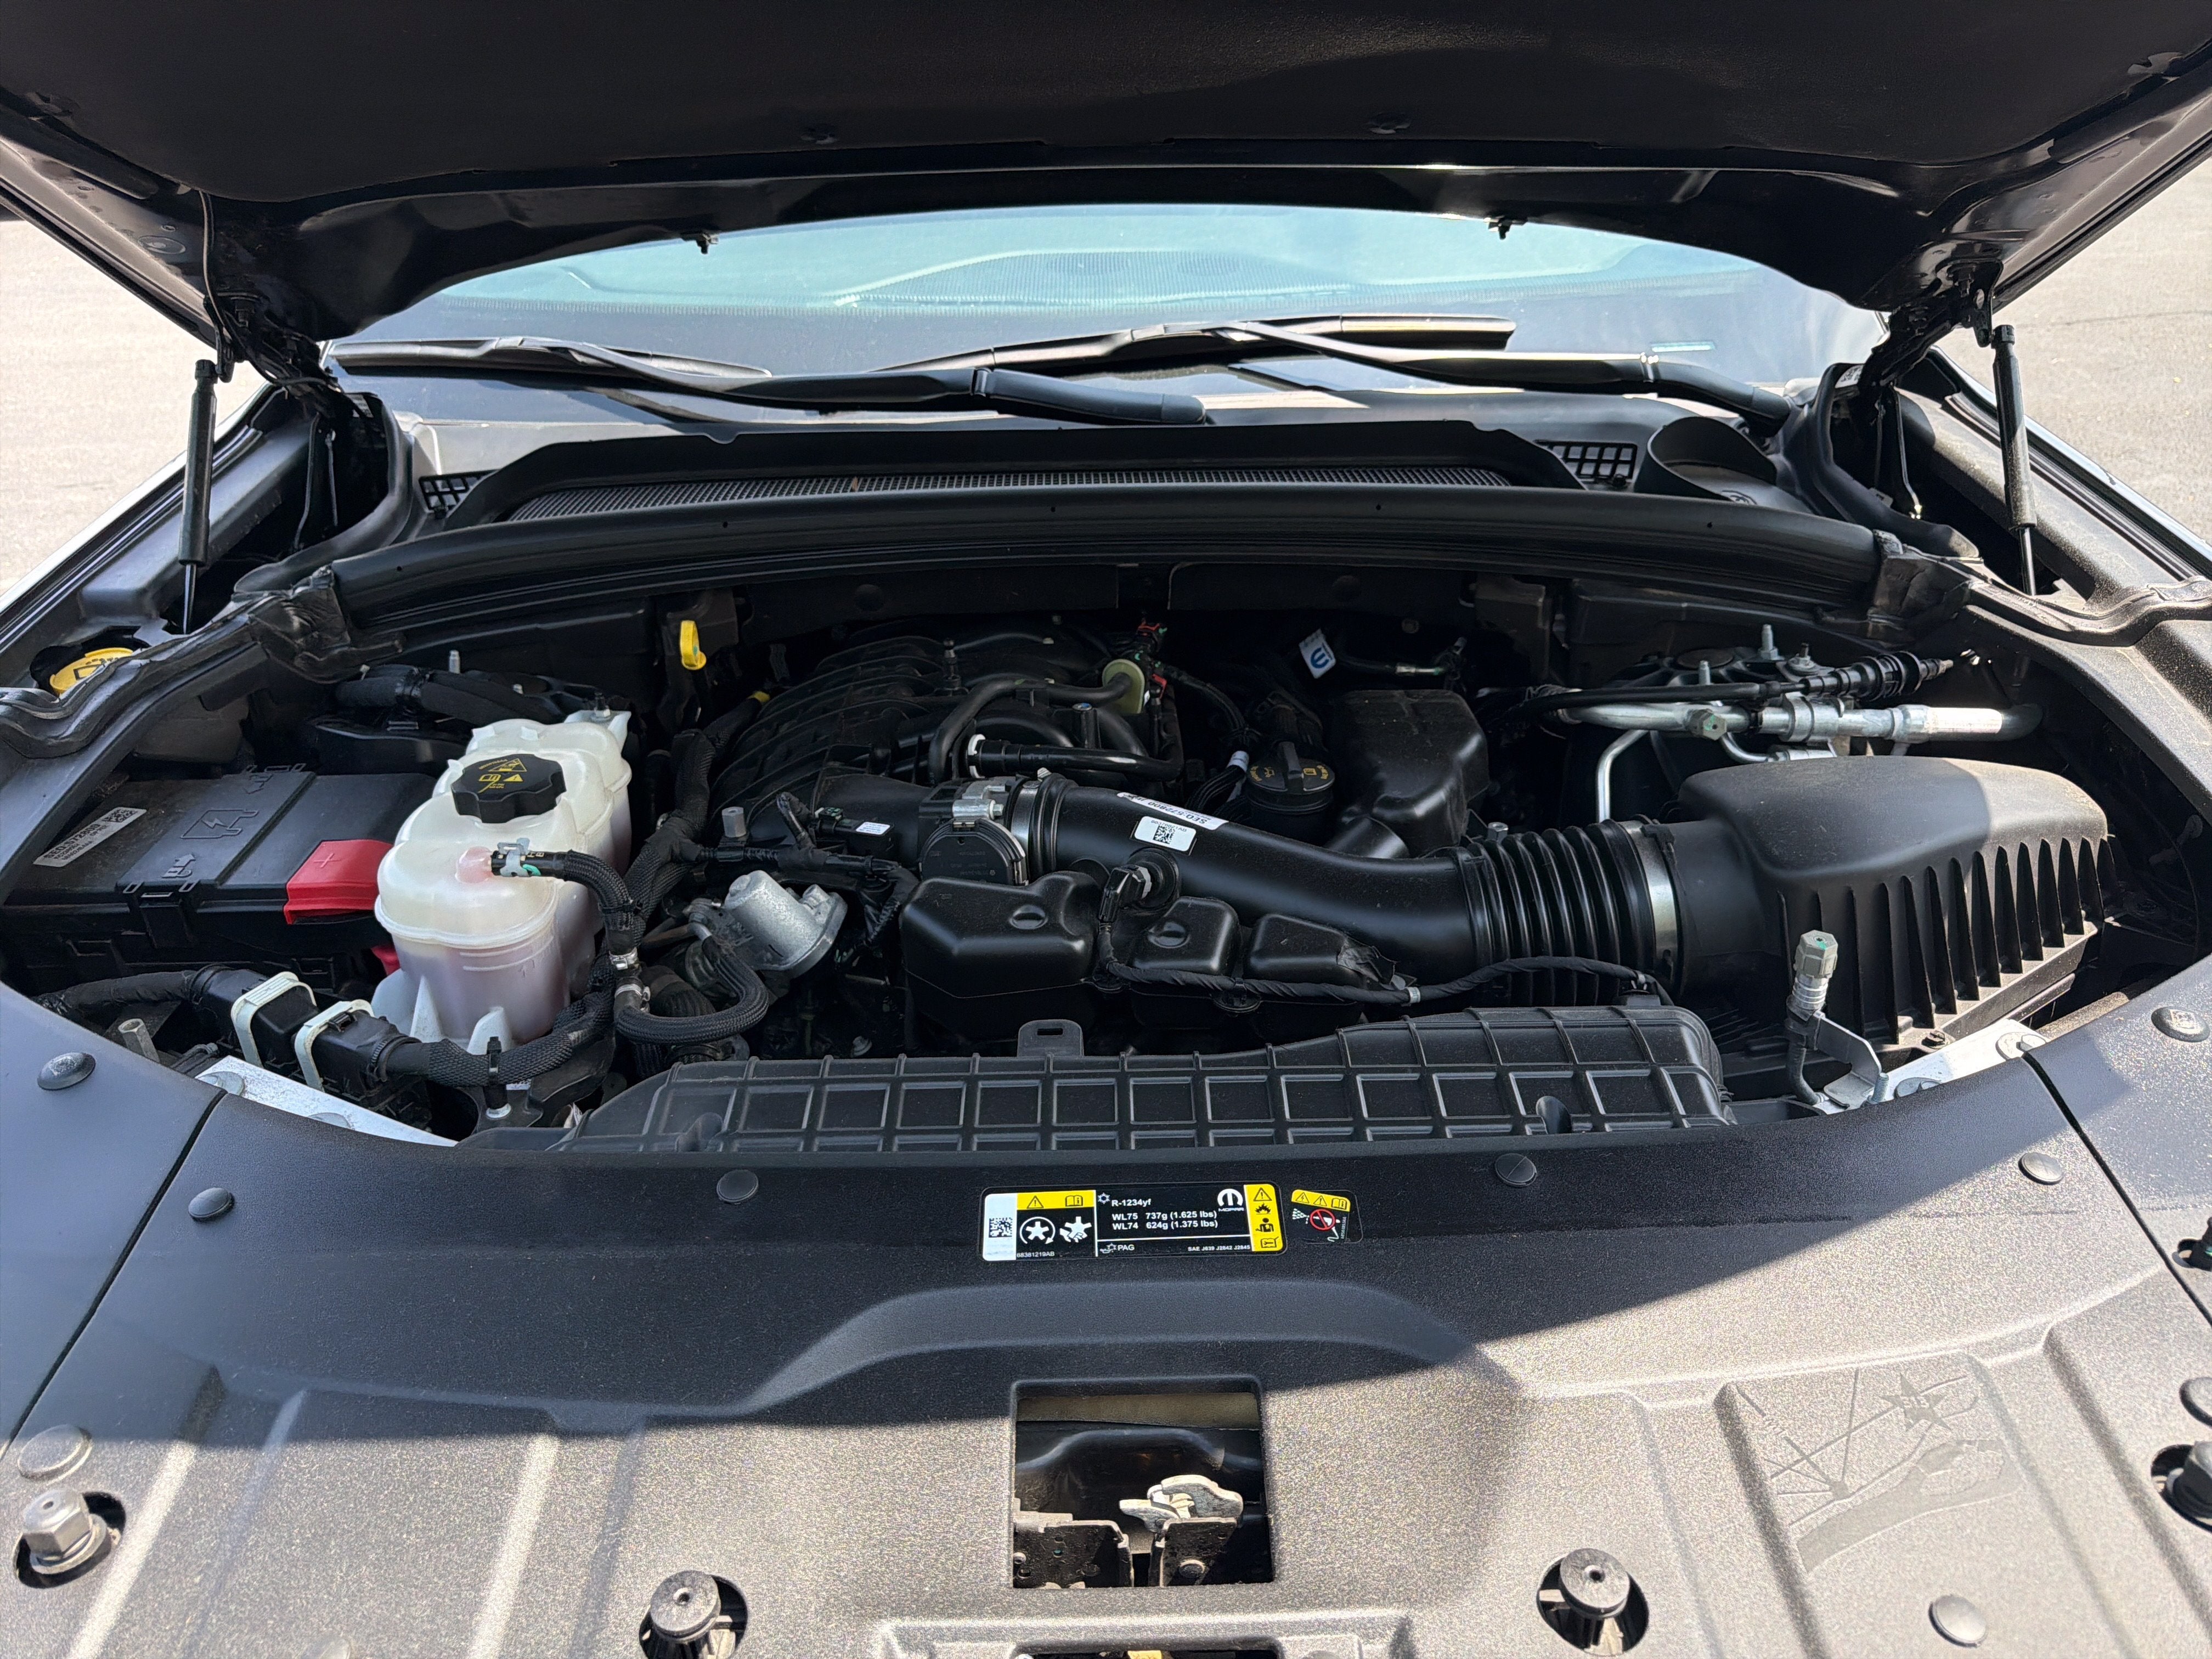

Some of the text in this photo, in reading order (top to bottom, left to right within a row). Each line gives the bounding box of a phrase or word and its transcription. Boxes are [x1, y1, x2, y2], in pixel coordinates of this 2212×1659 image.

[1111, 1198, 1151, 1207] R-1234yf
[1146, 1212, 1167, 1221] 737g
[1170, 1211, 1197, 1220] (1.625
[1200, 1210, 1217, 1218] lbs)
[1146, 1221, 1169, 1230] 624g
[1171, 1221, 1198, 1229] (1.375
[1200, 1220, 1218, 1228] lbs)
